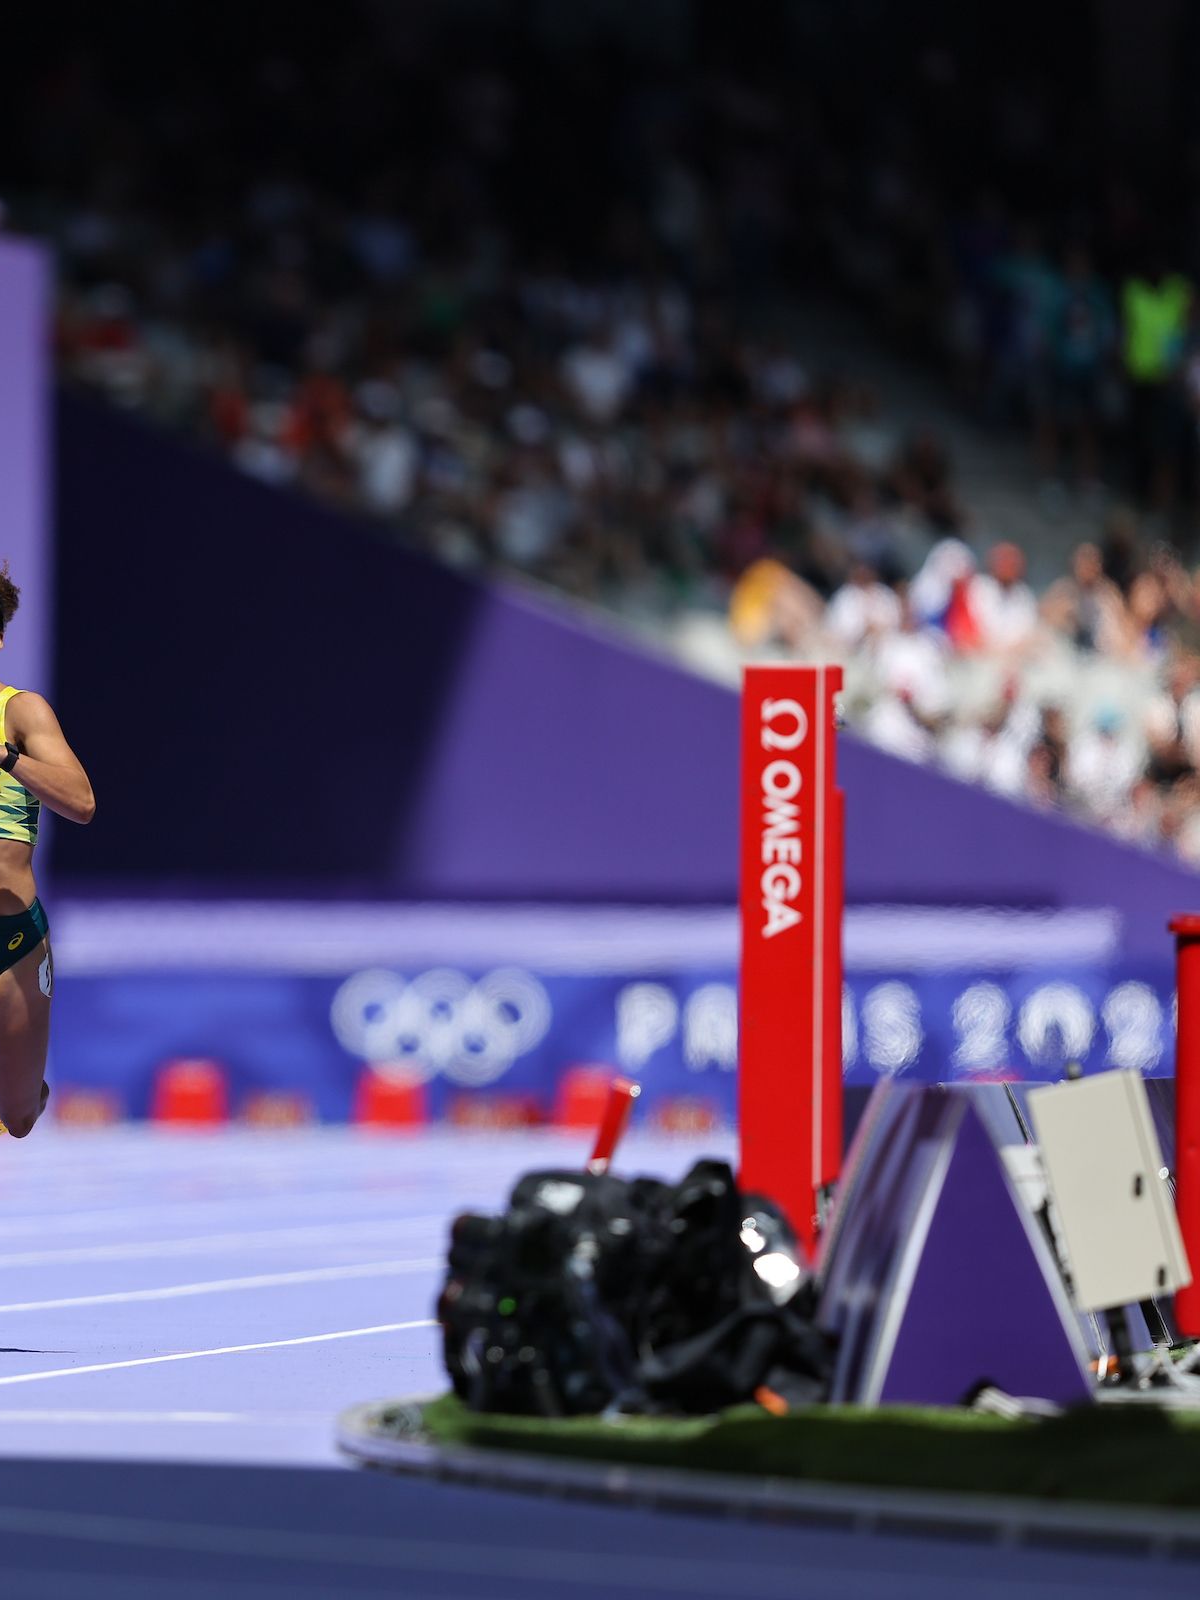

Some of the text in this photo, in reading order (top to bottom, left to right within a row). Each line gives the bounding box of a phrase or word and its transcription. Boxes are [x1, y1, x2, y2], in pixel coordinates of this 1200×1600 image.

[761, 760, 803, 938] OMEGA
[615, 981, 1164, 1072] PAS 202
